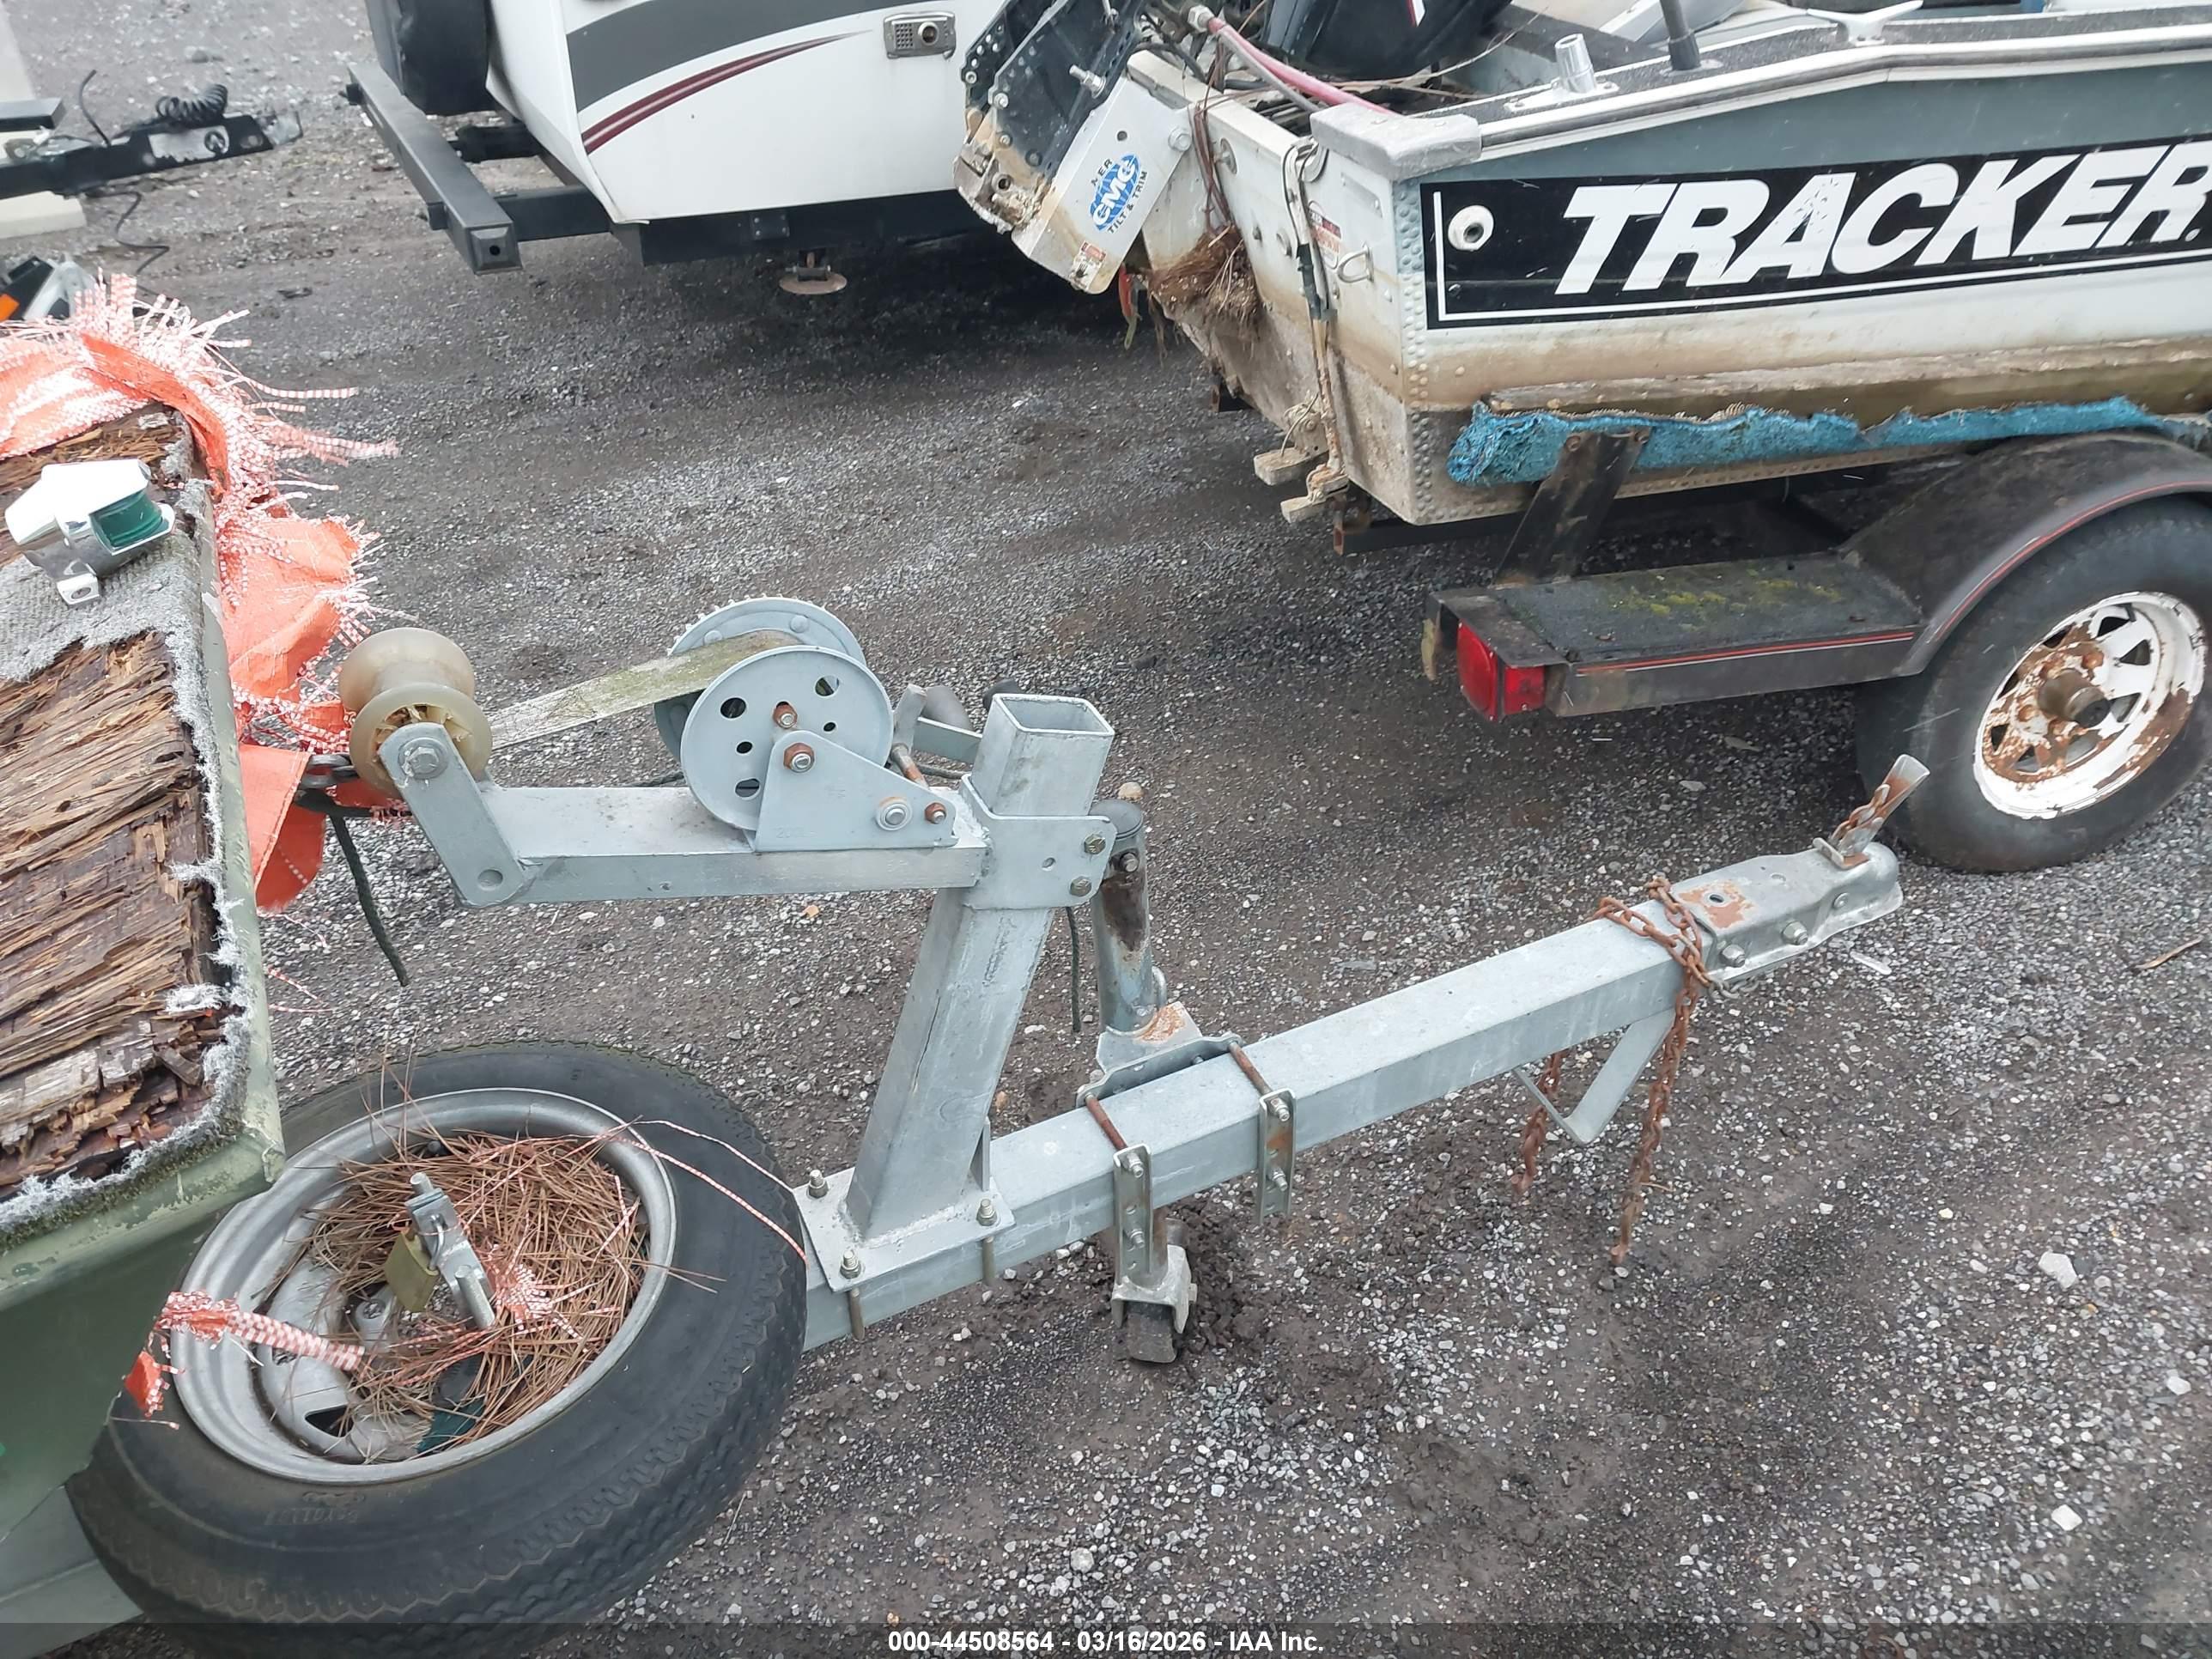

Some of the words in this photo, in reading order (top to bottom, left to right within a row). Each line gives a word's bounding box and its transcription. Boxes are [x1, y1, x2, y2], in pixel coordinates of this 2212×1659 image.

[1108, 212, 1127, 234] TILT
[1133, 171, 1148, 198] TRIM
[1554, 140, 2212, 295] TRACKER
